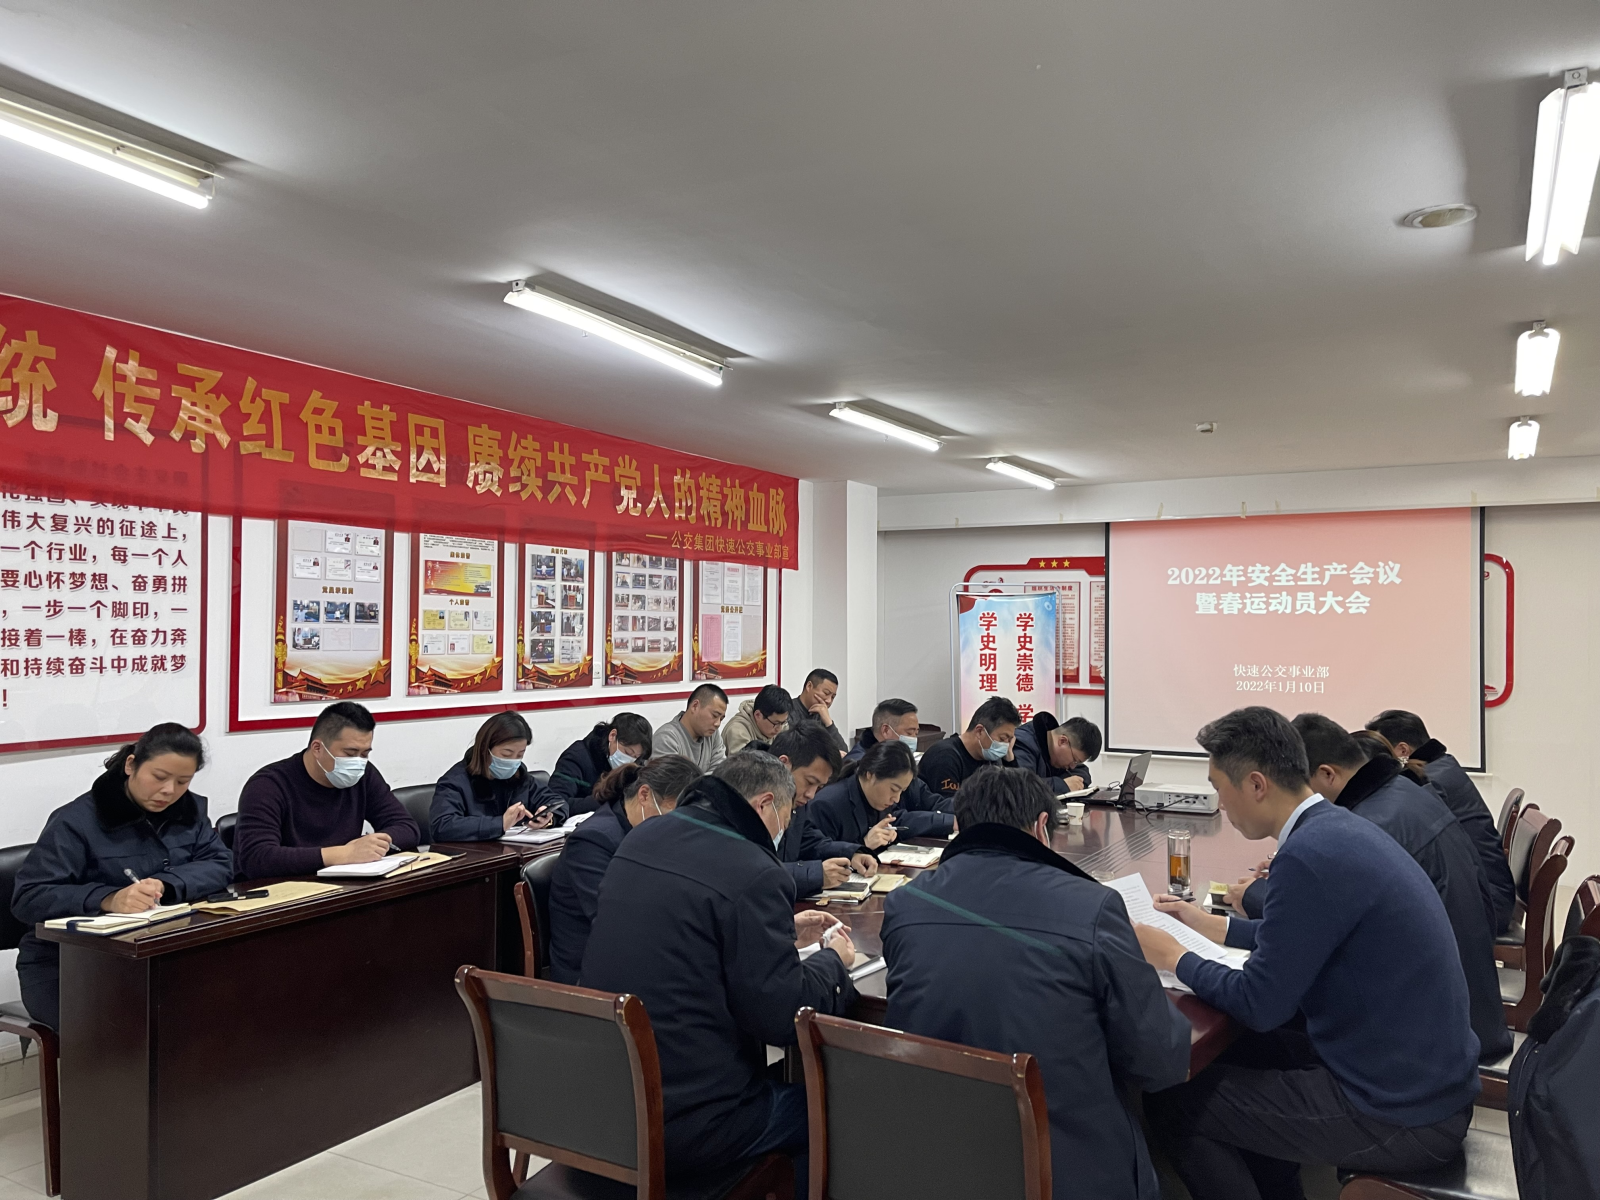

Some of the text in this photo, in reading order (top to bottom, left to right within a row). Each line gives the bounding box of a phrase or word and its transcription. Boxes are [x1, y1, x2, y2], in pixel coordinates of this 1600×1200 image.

[0, 324, 787, 538] 统 传承红色基因 赓续共产党人的精神血脉
[1, 510, 188, 541] 伟大复兴的征途上，
[0, 541, 188, 567] 一个行业，每一个人
[0, 569, 188, 594] 要心怀梦想、奋勇拼
[1167, 561, 1403, 587] 2022年安全生产会议
[1195, 590, 1371, 615] 暨春运动员大会
[0, 628, 187, 648] 接着一棒，在奋力奔
[978, 611, 998, 692] 学史明理
[1016, 612, 1034, 692] 学史崇德
[0, 654, 187, 677] 和持续奋斗中成就梦
[1233, 663, 1330, 679] 快速公交事业部
[1236, 680, 1325, 694] 2022年1月10日
